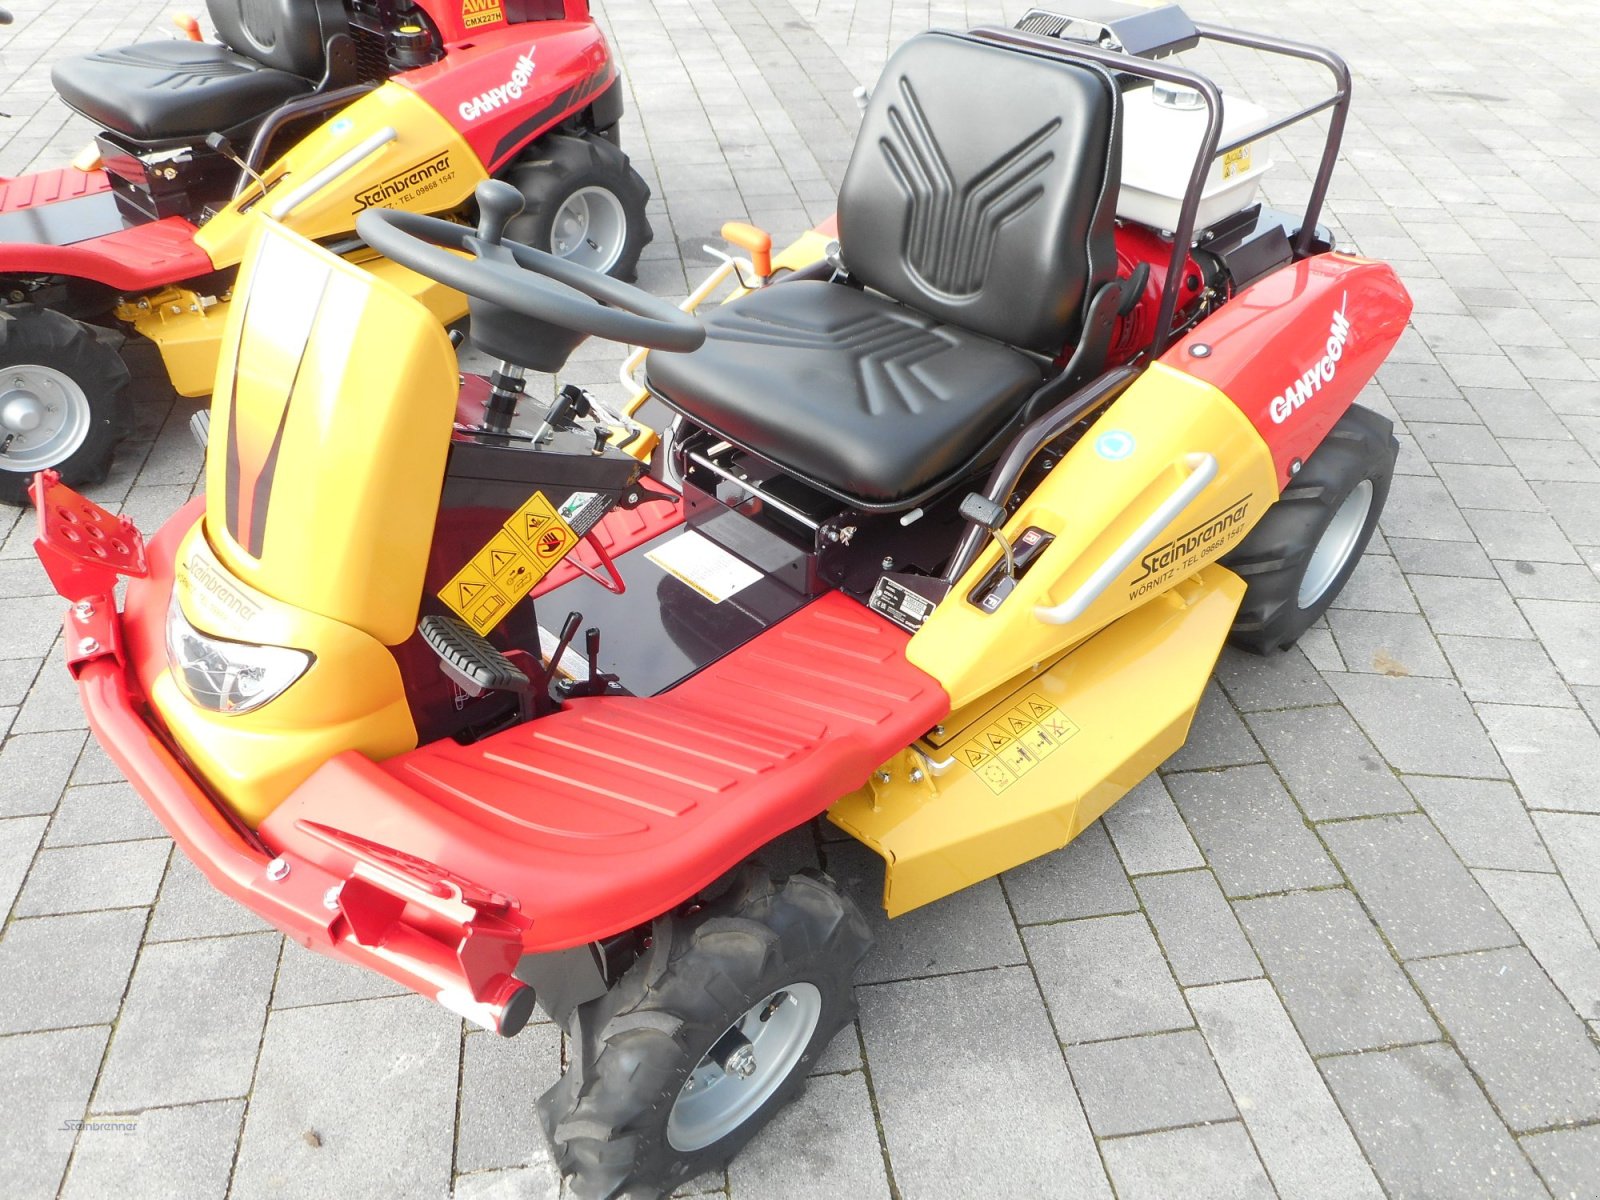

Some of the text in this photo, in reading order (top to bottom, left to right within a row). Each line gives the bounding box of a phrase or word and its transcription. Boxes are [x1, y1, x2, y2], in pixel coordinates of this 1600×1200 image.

[465, 12, 502, 27] CMX227H
[352, 150, 450, 215] Steinbrenner
[399, 194, 415, 205] TEL
[438, 171, 456, 184] 1547
[1128, 567, 1175, 601] WÖRNITZ
[1182, 554, 1199, 570] TEL
[1227, 523, 1246, 541] 1547
[1130, 493, 1253, 586] Steinbrenner
[183, 553, 263, 621] Steinbrenner
